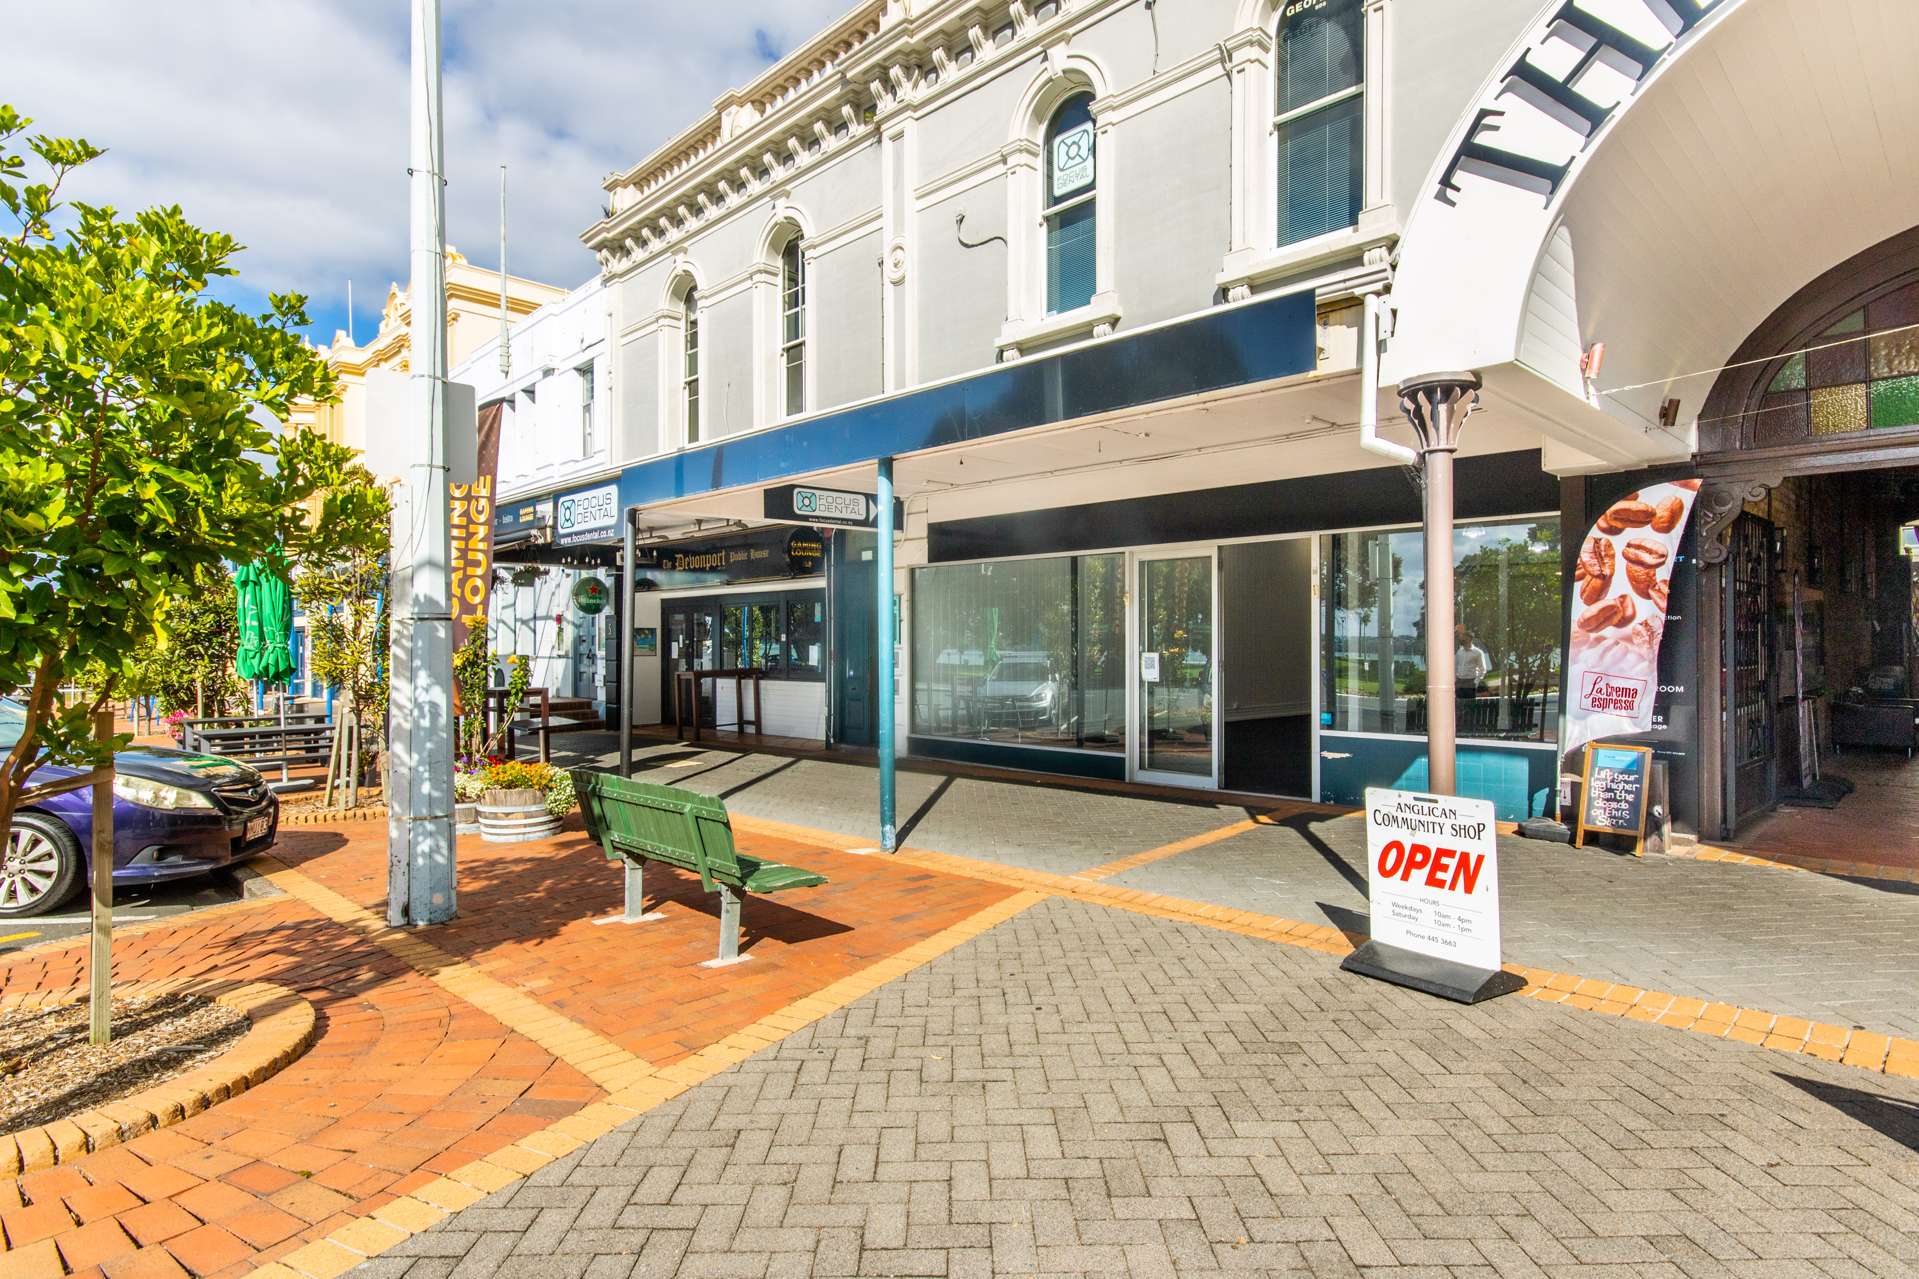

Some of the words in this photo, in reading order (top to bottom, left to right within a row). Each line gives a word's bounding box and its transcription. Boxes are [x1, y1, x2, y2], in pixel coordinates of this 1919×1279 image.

[1286, 0, 1320, 16] GEO
[577, 492, 612, 511] FOCUS
[818, 494, 861, 507] FOCUS
[577, 507, 615, 525] DENTAL
[818, 503, 864, 516] DENTAL
[461, 475, 492, 629] LOUNGE
[791, 540, 822, 549] GAMING
[791, 549, 823, 557] LOUNGE
[675, 549, 726, 571] Devonport
[1584, 675, 1605, 699] La
[1605, 683, 1638, 699] Crema
[1591, 696, 1635, 711] espresso
[1607, 780, 1640, 792] higher
[1614, 772, 1639, 783] your
[1396, 802, 1457, 820] ANGLICAN
[1373, 809, 1445, 835] COMMUNITY
[1450, 823, 1486, 840] SHOP
[1377, 840, 1486, 895] OPEN
[1419, 898, 1440, 907] HOURS
[1391, 901, 1423, 914] Weekdays
[1434, 910, 1452, 920] 10am
[1457, 915, 1473, 925] 4pm
[1391, 910, 1419, 922] Saturday
[1434, 919, 1452, 929] 10am
[1457, 924, 1472, 933] 1pm
[1405, 929, 1426, 940] Phone
[1427, 935, 1439, 943] 445
